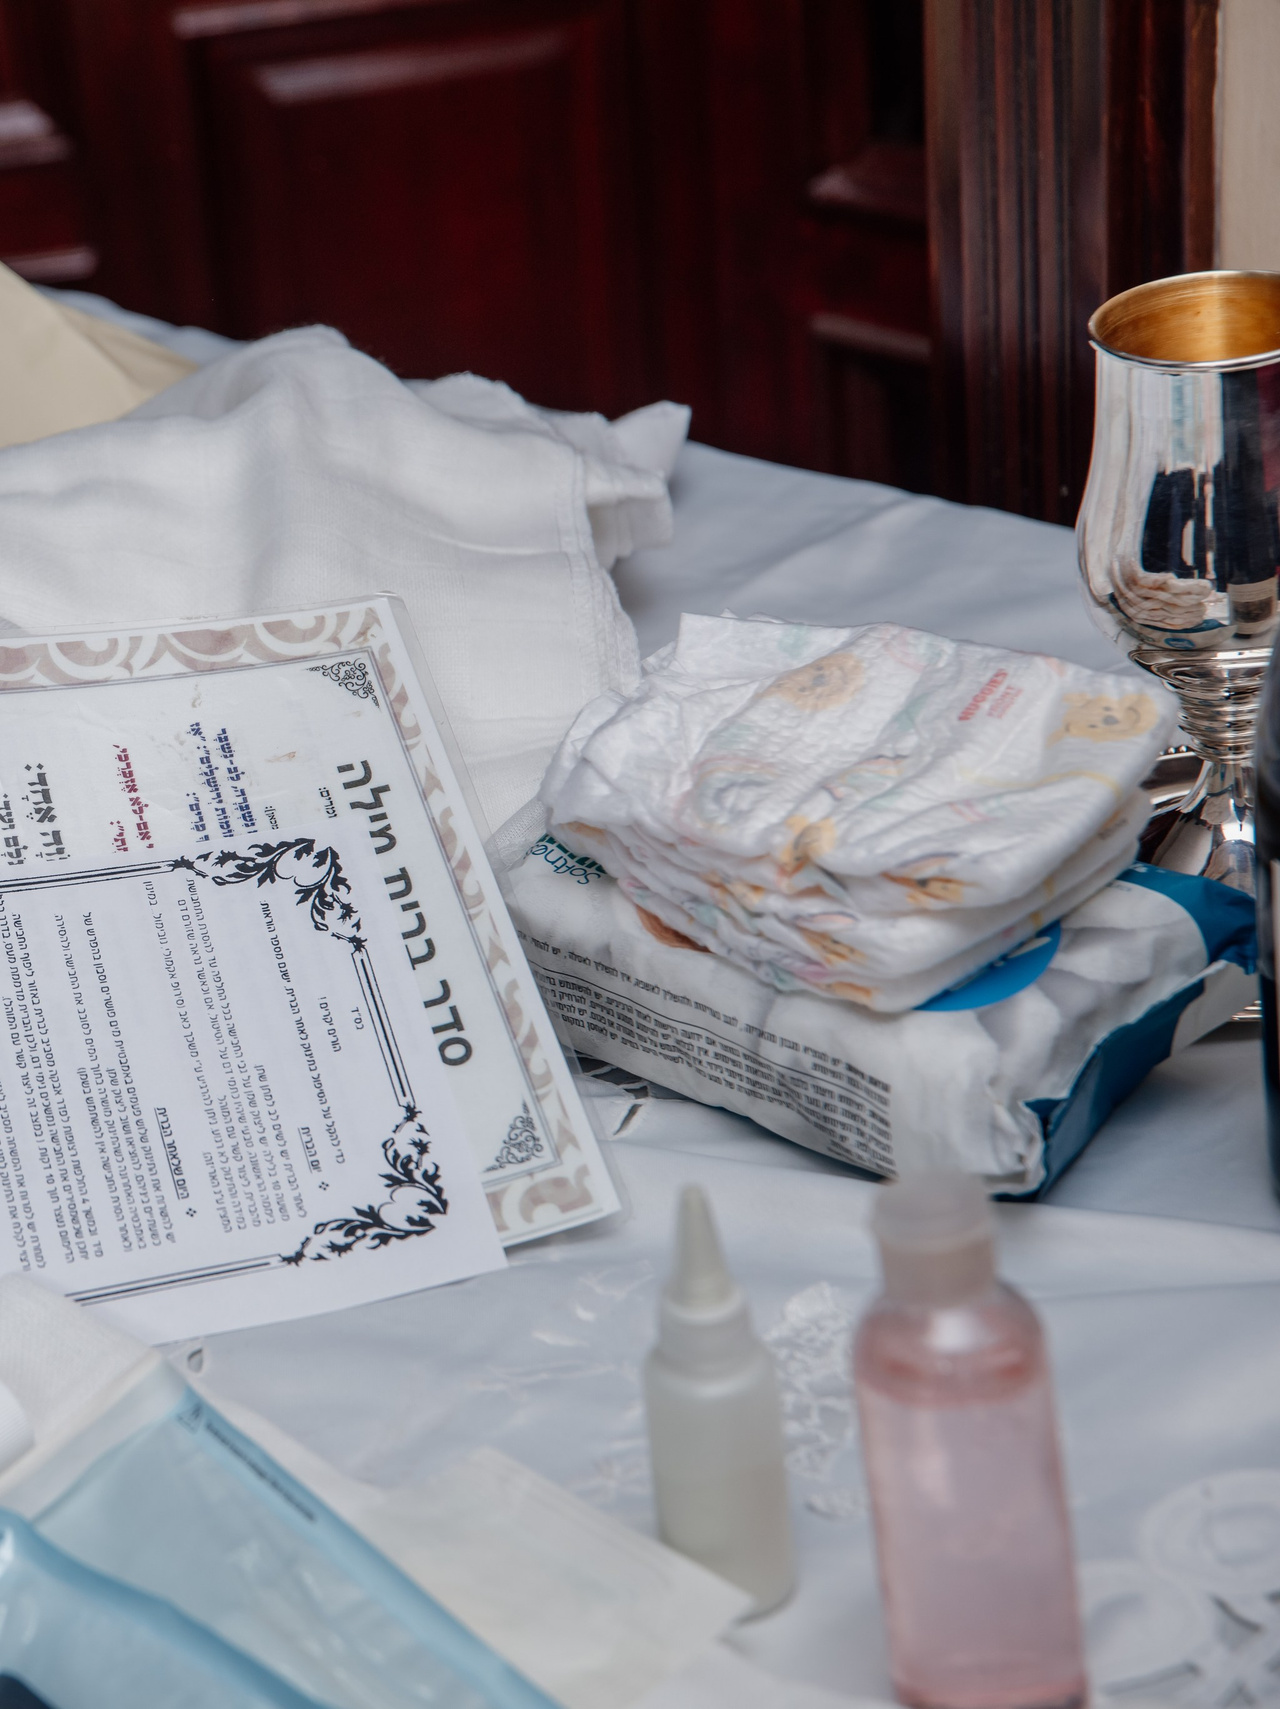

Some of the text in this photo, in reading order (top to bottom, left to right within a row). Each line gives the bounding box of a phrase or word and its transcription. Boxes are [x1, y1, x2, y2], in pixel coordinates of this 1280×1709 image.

[317, 786, 338, 818] ומרים:
[335, 759, 473, 1066] סדר ברית מילה
[197, 922, 214, 953] להסרת
[269, 933, 284, 960] מספר
[207, 955, 218, 968] עד
[276, 961, 291, 983] ישנם
[210, 969, 227, 1001] החלפה
[220, 1001, 233, 1021] בכל
[318, 1001, 334, 1026] יקרים
[350, 1006, 364, 1030] בס"ד
[225, 1022, 243, 1058] החבישה
[293, 1015, 309, 1041] לאחר
[326, 1027, 342, 1052] הורים
[236, 1059, 248, 1074] גבי
[299, 1042, 318, 1072] בתינוק
[81, 910, 175, 1243] יש להשרות את התינוק שלוש פעמים באמבטיית מים פושרים וסבון בהפרש של
[241, 1074, 252, 1088] על
[310, 1072, 327, 1105] הטיפול
[243, 1089, 257, 1108] שמן
[258, 1083, 276, 1107] למתן
[248, 1109, 266, 1134] ליצוק
[266, 1108, 280, 1121] לב
[320, 1105, 332, 1119] על
[257, 1135, 268, 1150] יש
[271, 1122, 287, 1147] לשים
[324, 1120, 341, 1147] להקל
[5, 1135, 22, 1172] המשחה
[153, 1106, 190, 1199] היום שלאחר הברית
[278, 1148, 290, 1160] יש
[299, 1125, 322, 1172] יום הברית
[334, 1148, 345, 1164] כדי
[262, 1149, 277, 1177] בלילה
[14, 1173, 25, 1188] את
[282, 1162, 299, 1191] הברית
[18, 1189, 34, 1219] למרוח
[274, 1192, 290, 1221] משעה
[292, 1191, 307, 1218] לאחר
[26, 1220, 36, 1232] יש
[29, 1234, 46, 1268] למחרת
